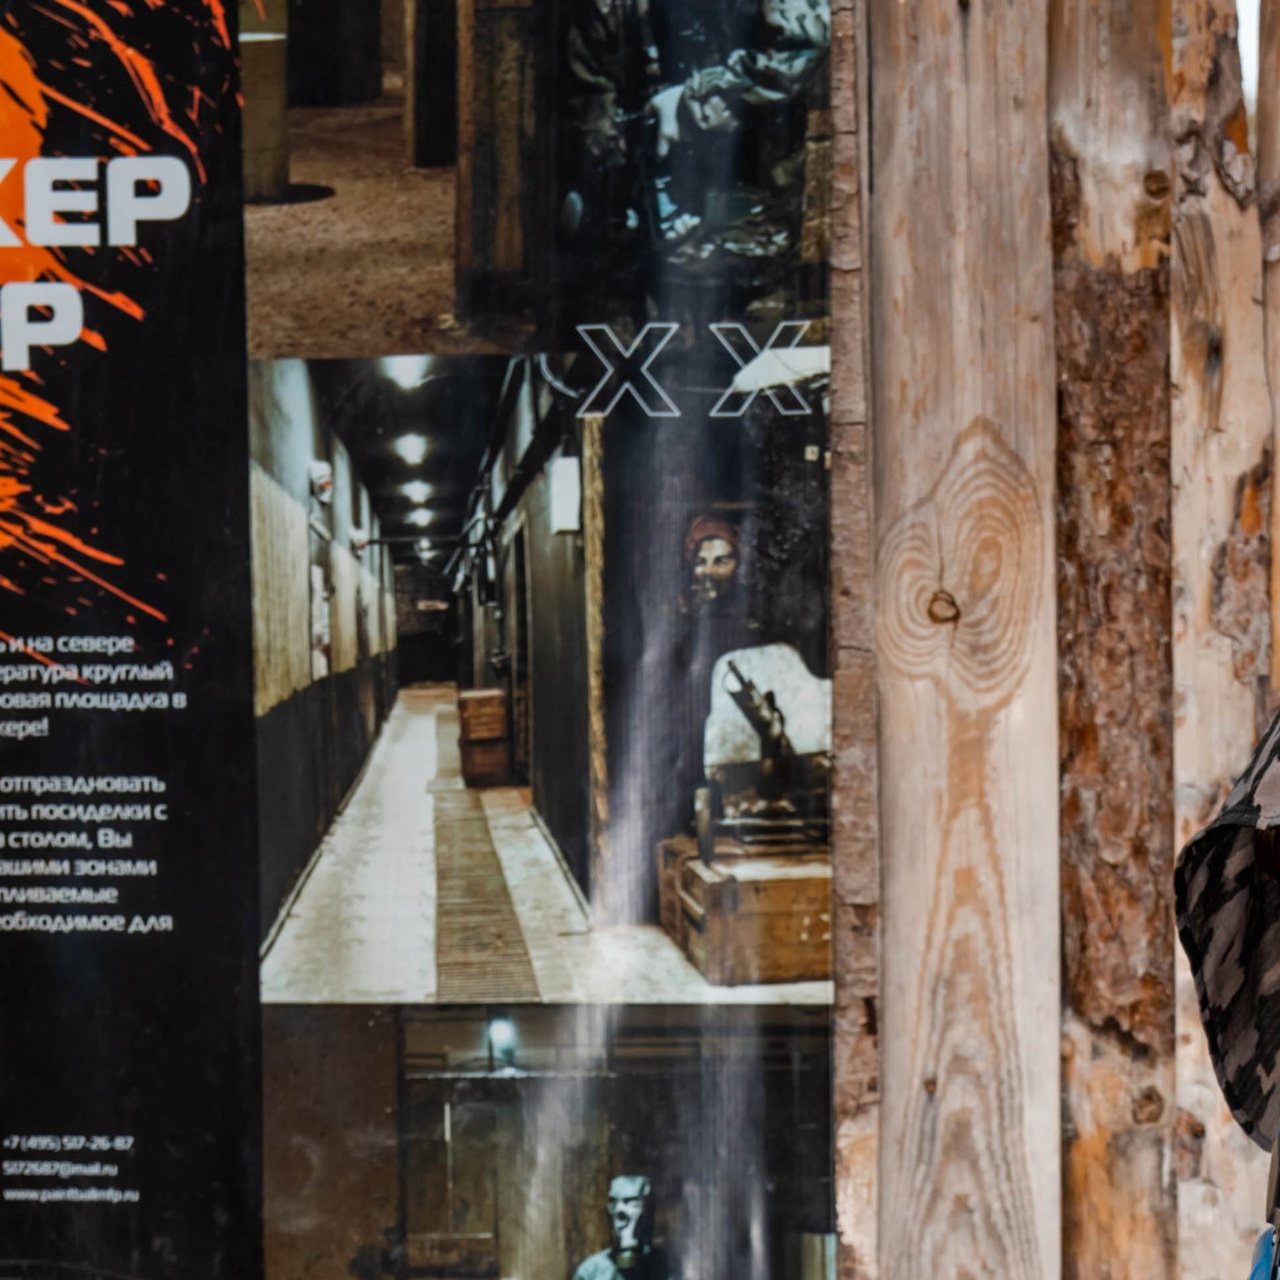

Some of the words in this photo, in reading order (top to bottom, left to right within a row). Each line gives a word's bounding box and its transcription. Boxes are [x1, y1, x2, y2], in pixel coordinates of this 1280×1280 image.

[0, 156, 191, 246] ЕР
[27, 635, 54, 653] на
[57, 635, 136, 656] севере
[0, 663, 79, 685] ратура
[82, 660, 174, 685] круглый
[54, 691, 169, 712] площадка
[172, 691, 187, 709] в
[0, 775, 166, 797] отпраздновать
[30, 803, 151, 823] посиделки
[153, 803, 168, 821] с
[7, 832, 93, 850] столом,
[97, 827, 133, 848] Вы
[73, 859, 157, 876] зонами
[127, 914, 174, 934] для
